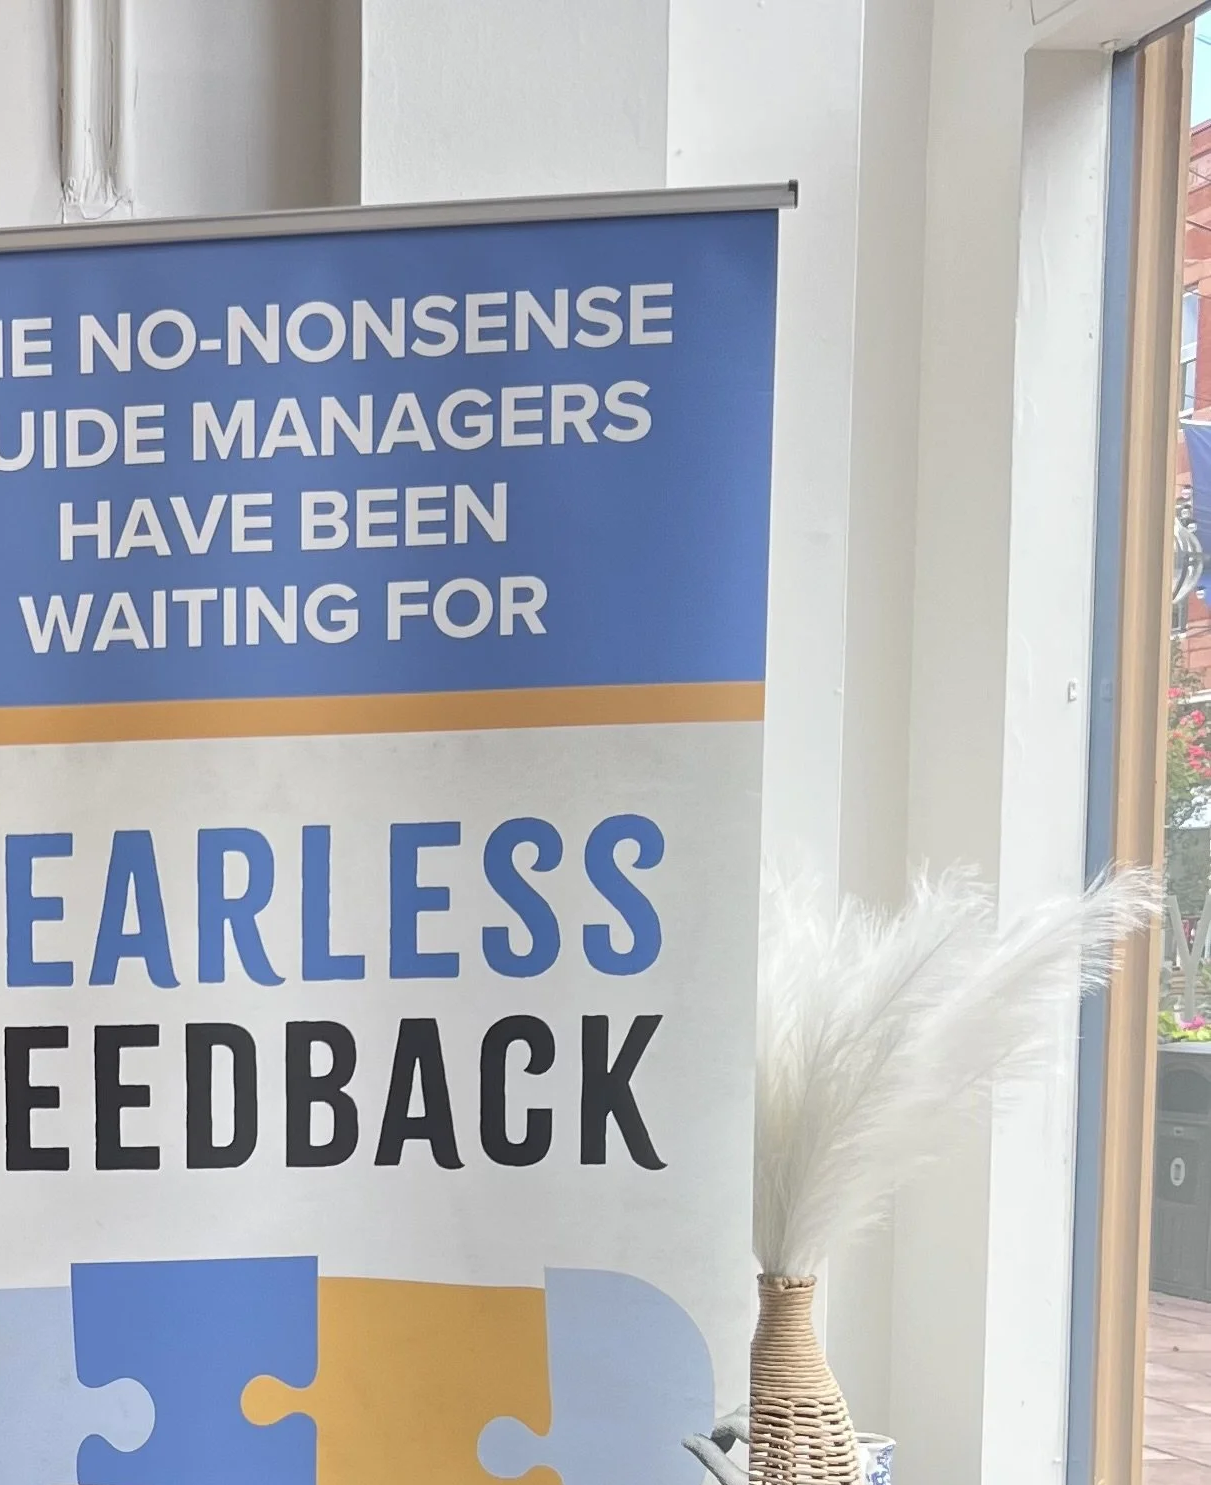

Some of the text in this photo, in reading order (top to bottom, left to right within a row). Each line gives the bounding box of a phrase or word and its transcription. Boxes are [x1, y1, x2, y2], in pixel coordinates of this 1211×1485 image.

[79, 281, 674, 376] NO-NONSENSE
[191, 379, 653, 464] MANAGERS
[58, 480, 509, 563] HAVE BEEN
[18, 573, 548, 656] WAITING FOR
